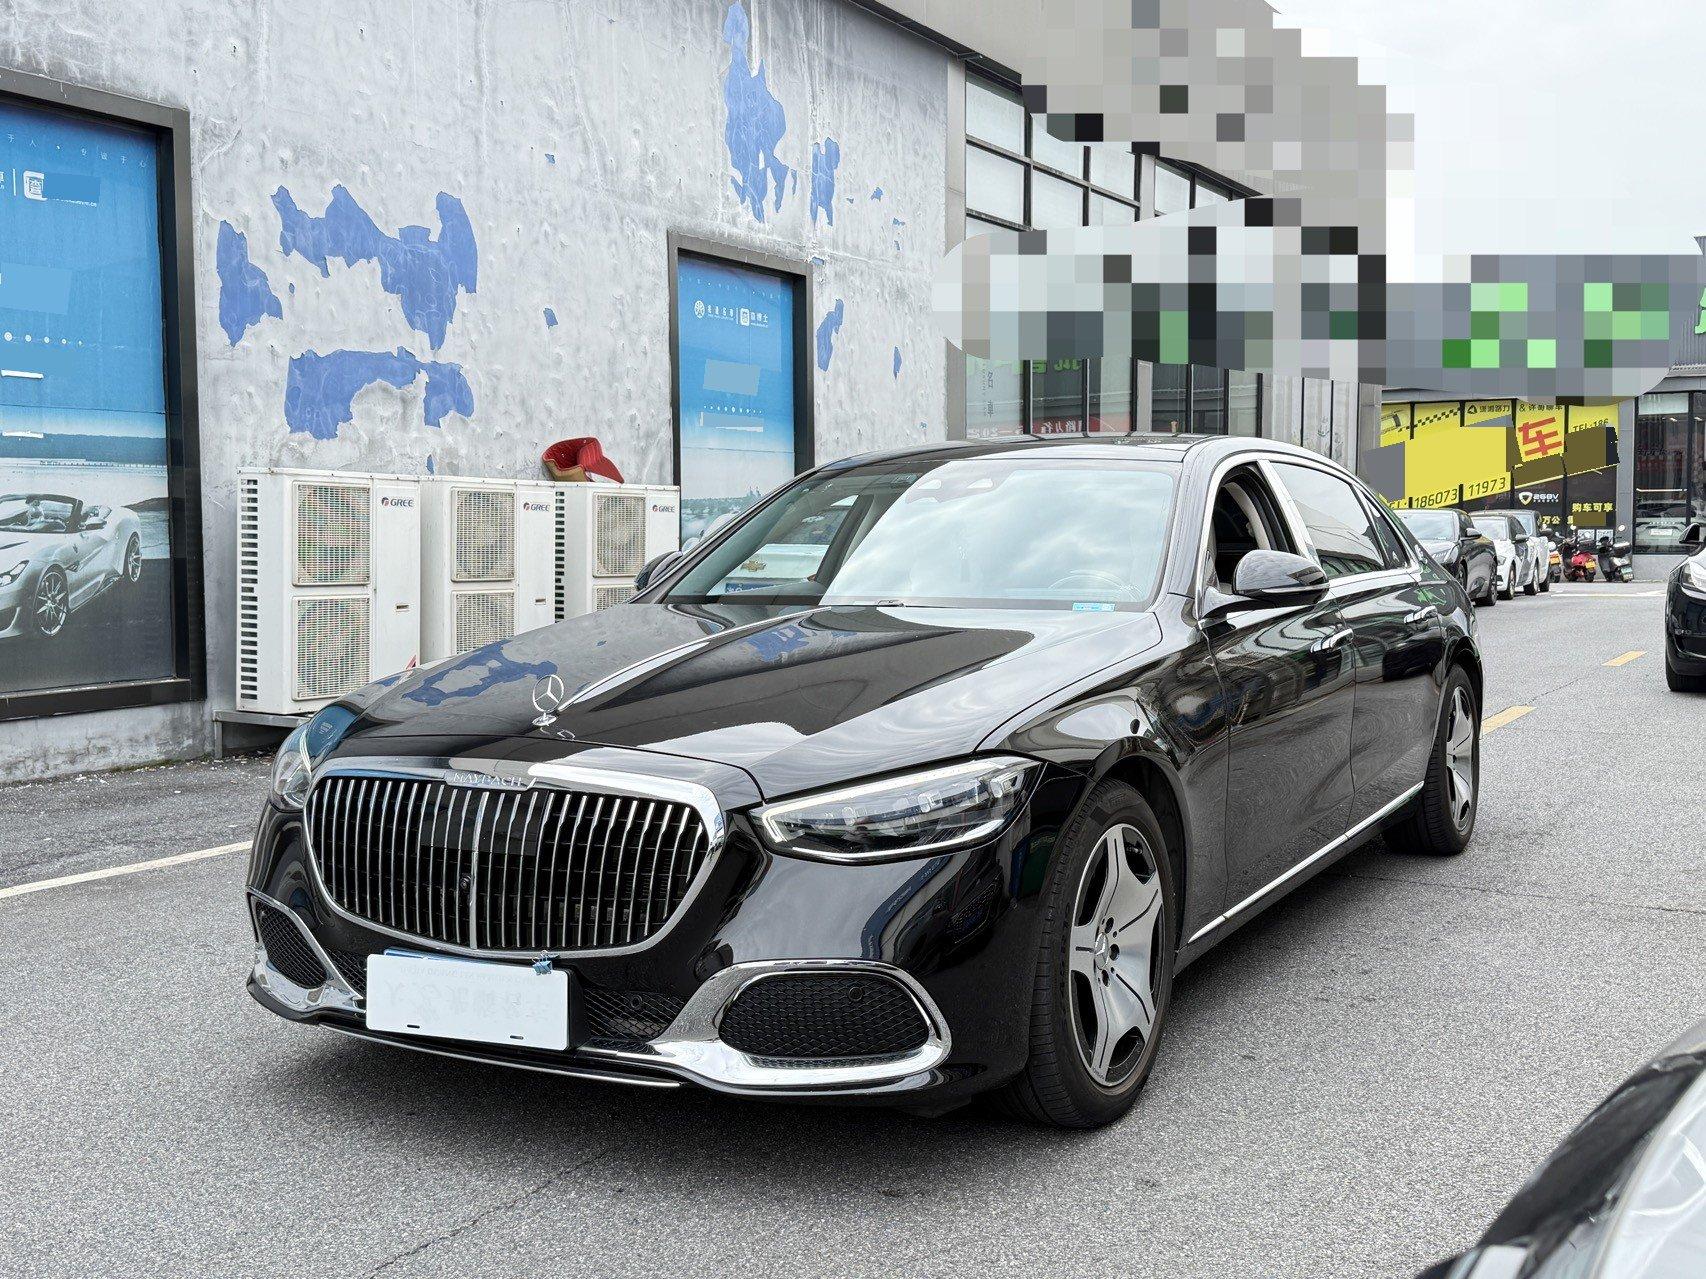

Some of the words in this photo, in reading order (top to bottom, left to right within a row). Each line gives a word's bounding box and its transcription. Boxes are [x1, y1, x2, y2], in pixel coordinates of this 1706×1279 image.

[1518, 416, 1563, 456] 车
[1414, 488, 1458, 508] 186073
[1468, 476, 1507, 497] 11973
[390, 499, 414, 508] GREE
[530, 503, 550, 512] GREE
[658, 504, 676, 513] GREE
[1572, 502, 1614, 513] 购车可享
